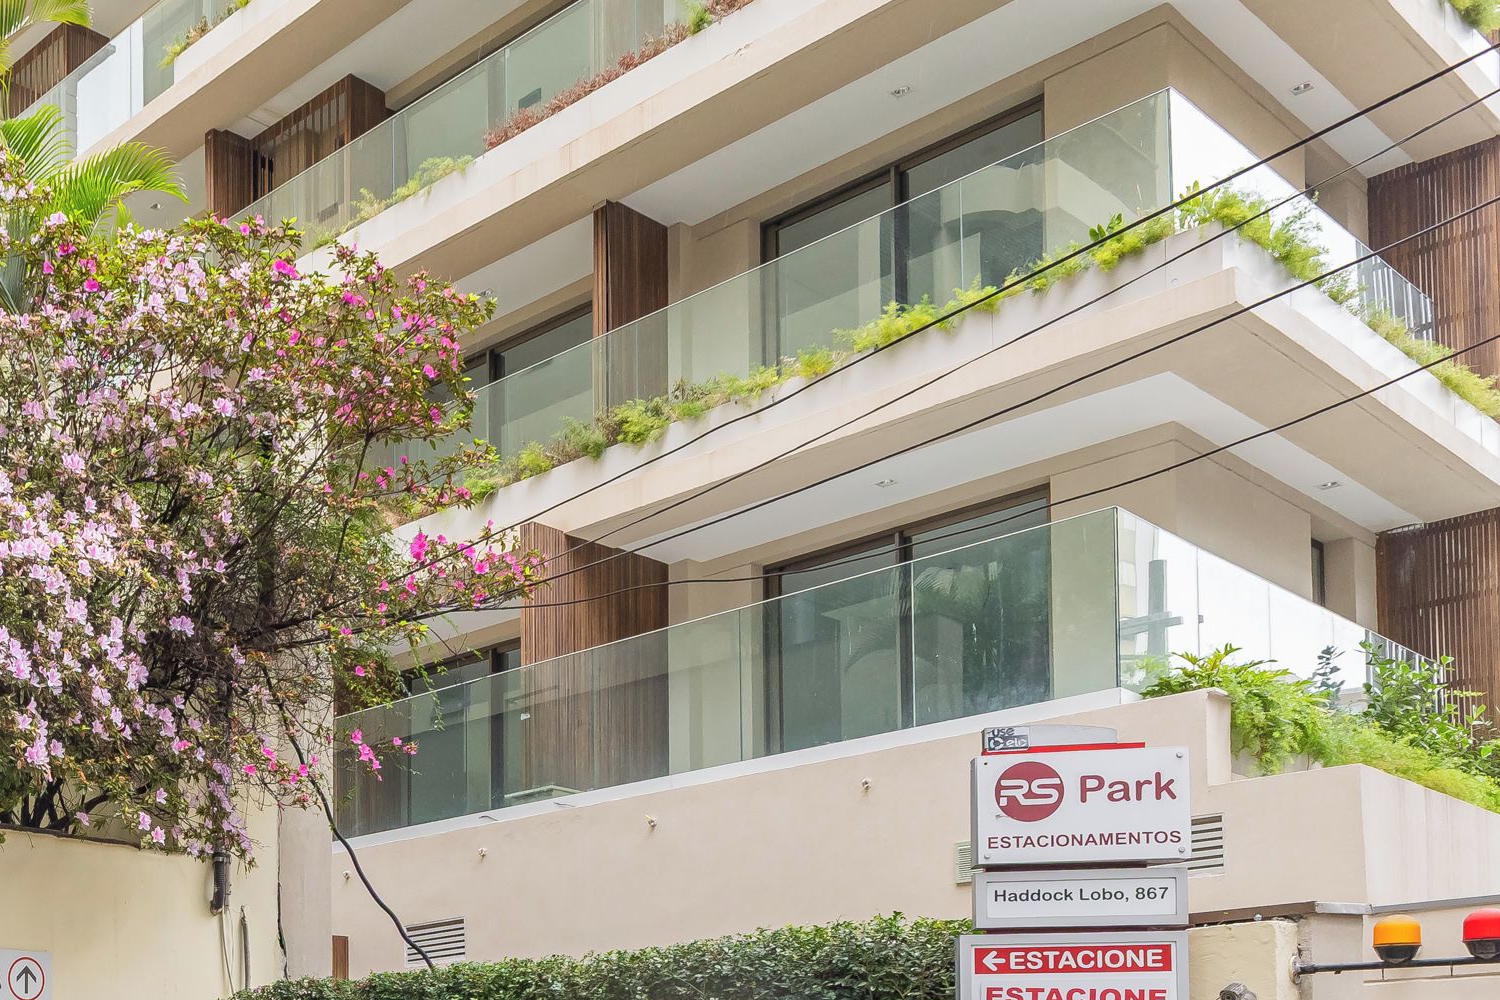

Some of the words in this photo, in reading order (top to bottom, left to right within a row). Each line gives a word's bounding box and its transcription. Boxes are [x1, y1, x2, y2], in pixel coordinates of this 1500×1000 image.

[1000, 777, 1061, 806] RS
[1080, 771, 1177, 803] Park
[988, 831, 1181, 849] ESTACIONAMENTOS
[994, 888, 1074, 902] Haddock
[1079, 888, 1129, 902] Lobo,
[1135, 887, 1169, 900] 867
[1009, 949, 1164, 970] ESTACIONE
